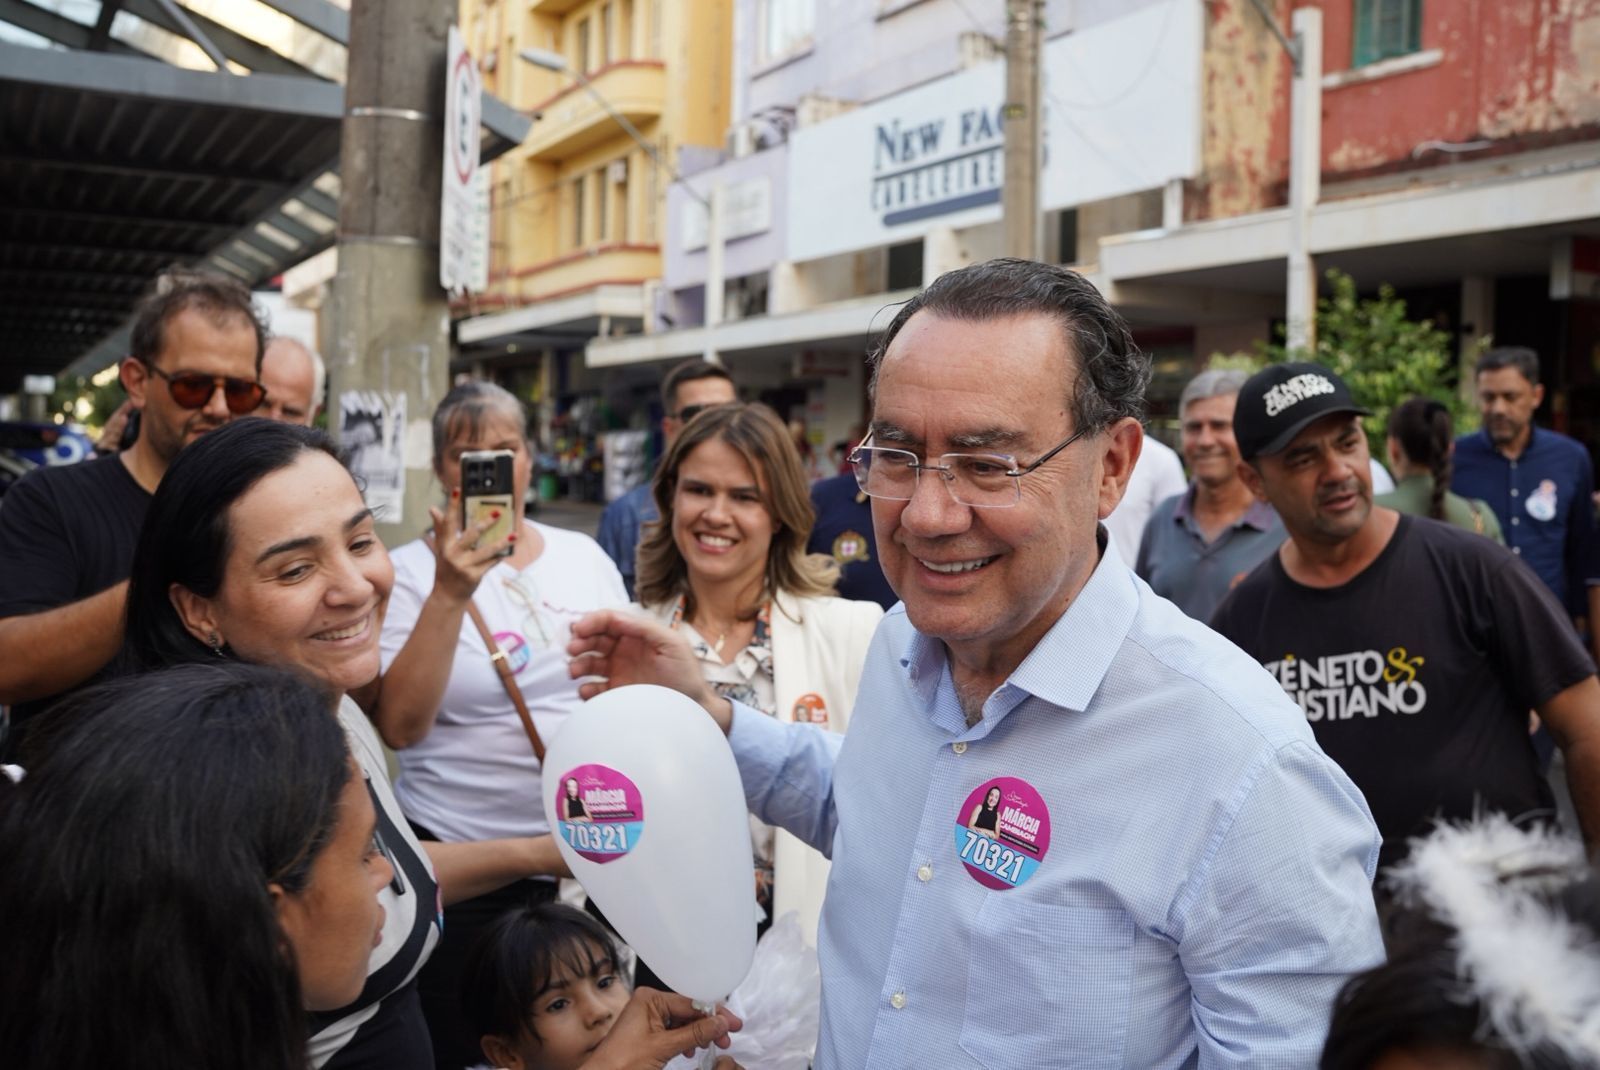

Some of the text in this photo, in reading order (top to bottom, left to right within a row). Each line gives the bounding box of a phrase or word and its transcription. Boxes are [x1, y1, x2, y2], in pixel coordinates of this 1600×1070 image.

[961, 106, 1004, 146] FAC
[1383, 647, 1425, 684] &
[1286, 680, 1427, 722] ISTIANO
[566, 824, 628, 851] 70321
[1001, 806, 1041, 835] MÁRCIA
[960, 831, 1025, 884] 70321
